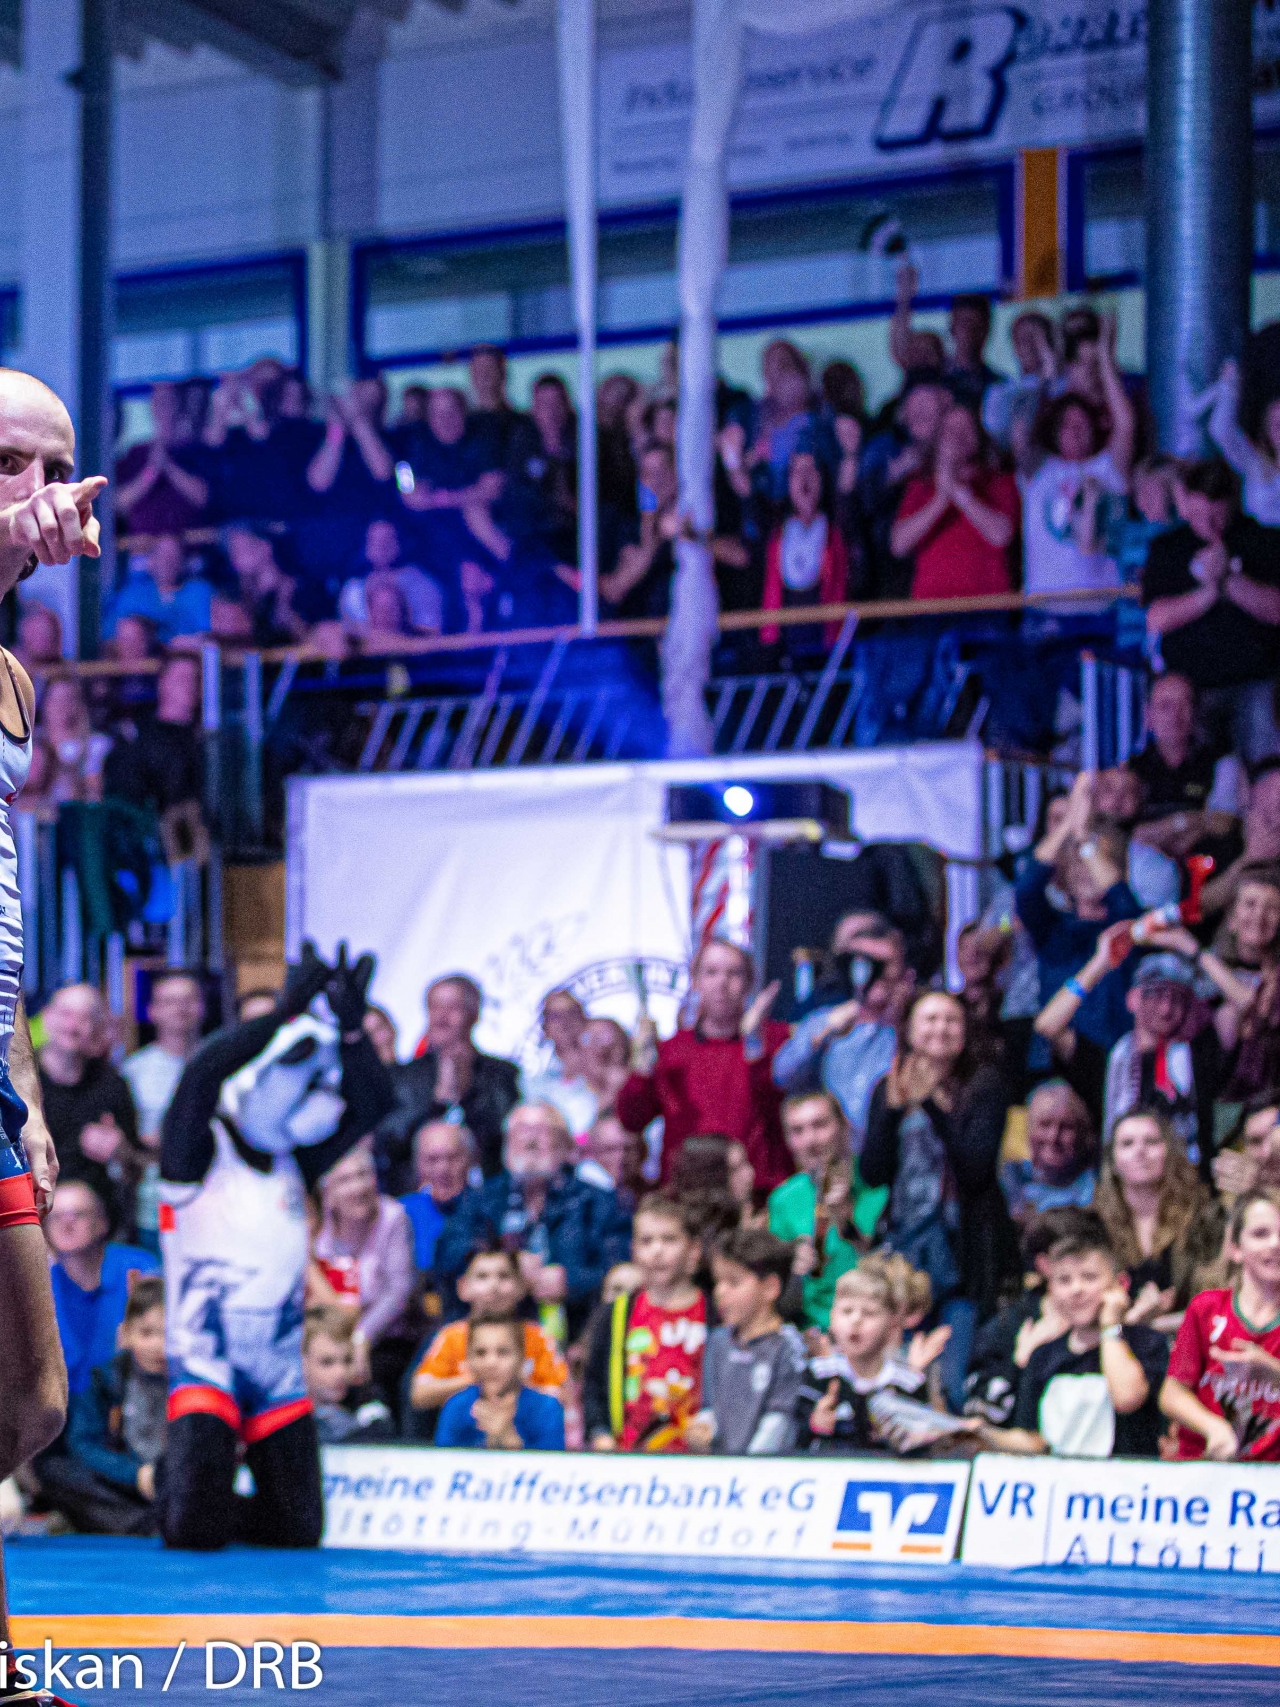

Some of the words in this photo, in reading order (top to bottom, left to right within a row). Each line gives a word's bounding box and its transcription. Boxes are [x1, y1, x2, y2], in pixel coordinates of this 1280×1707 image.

[450, 1469, 744, 1511] Raiffeisenbank
[761, 1478, 817, 1513] eG
[978, 1480, 1037, 1520] VR
[1065, 1482, 1210, 1527] meine
